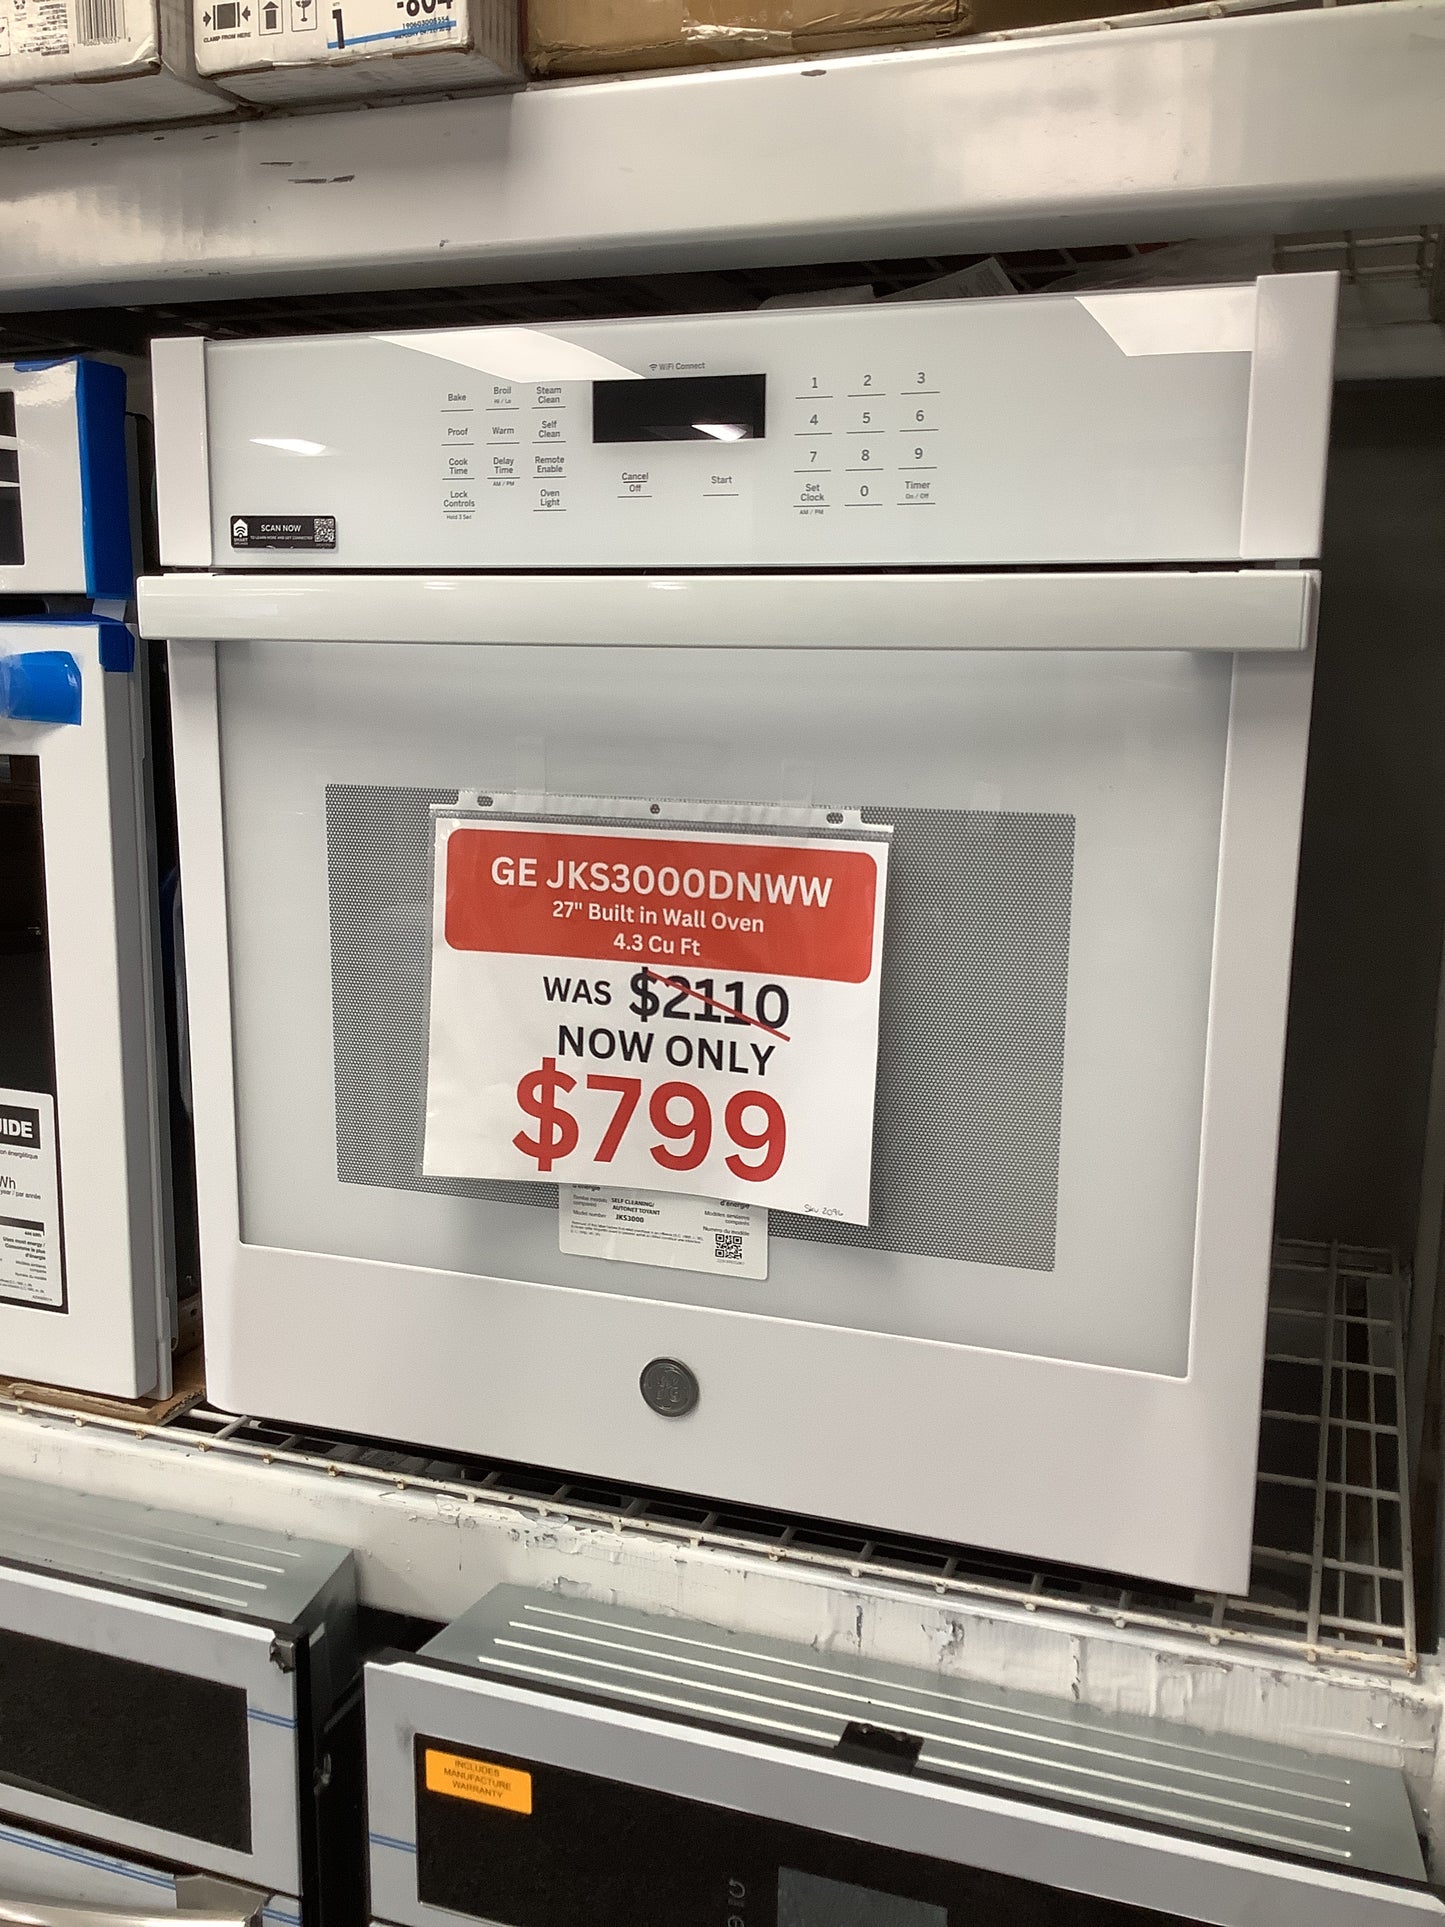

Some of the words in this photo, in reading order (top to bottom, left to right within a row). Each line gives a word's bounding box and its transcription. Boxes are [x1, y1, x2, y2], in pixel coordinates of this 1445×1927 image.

[332, 8, 345, 49] 1
[675, 362, 705, 370] Connect
[811, 377, 818, 389] 1
[863, 374, 872, 386] 2
[916, 372, 925, 384] 3
[493, 386, 512, 395] Broil
[536, 386, 562, 395] Steam
[447, 393, 467, 402] Bake
[537, 395, 561, 404] Clean
[809, 414, 819, 425] 4
[862, 412, 871, 424] 5
[915, 410, 925, 422] 6
[541, 420, 558, 429] Self
[447, 427, 469, 437] Proof
[492, 427, 515, 435] Warm
[538, 429, 561, 438] Clean
[809, 451, 817, 463] 7
[861, 449, 870, 461] 8
[914, 448, 923, 460] 9
[448, 458, 469, 467] Cook
[493, 456, 515, 467] Delay
[534, 455, 565, 464] Remote
[449, 467, 468, 475] Time
[494, 466, 514, 474] Time
[536, 464, 563, 474] Enable
[621, 472, 649, 481] Cancel
[711, 475, 733, 484] Start
[629, 484, 641, 493] Off
[805, 483, 820, 493] Set
[905, 480, 931, 490] Timer
[450, 490, 468, 499] Lock
[540, 489, 560, 498] Oven
[860, 485, 869, 497] 0
[800, 493, 825, 502] Clock
[443, 499, 476, 508] Controls
[540, 498, 561, 508] Light
[261, 524, 281, 532] SCAN
[282, 524, 302, 532] NOW
[490, 856, 538, 888] GE
[546, 859, 833, 908] JKS3000DNWW
[552, 900, 583, 920] 27"
[589, 902, 635, 924] Built
[639, 905, 657, 926] in
[662, 907, 706, 930] Wall
[711, 912, 765, 934] Oven
[613, 933, 644, 952] 4.3
[648, 935, 675, 955] Cu
[680, 937, 701, 957] Ft
[543, 976, 612, 1006] WAS
[629, 966, 791, 1031] $2110
[558, 1025, 653, 1063] NOW
[665, 1035, 776, 1076] ONLY
[511, 1056, 787, 1183] $799
[0, 1119, 33, 1138] IDE
[616, 1214, 644, 1223] JKS3000
[454, 1760, 500, 1778] INCLUDES
[443, 1767, 512, 1791] MANUFACTURE
[451, 1780, 504, 1799] WARRANTY
